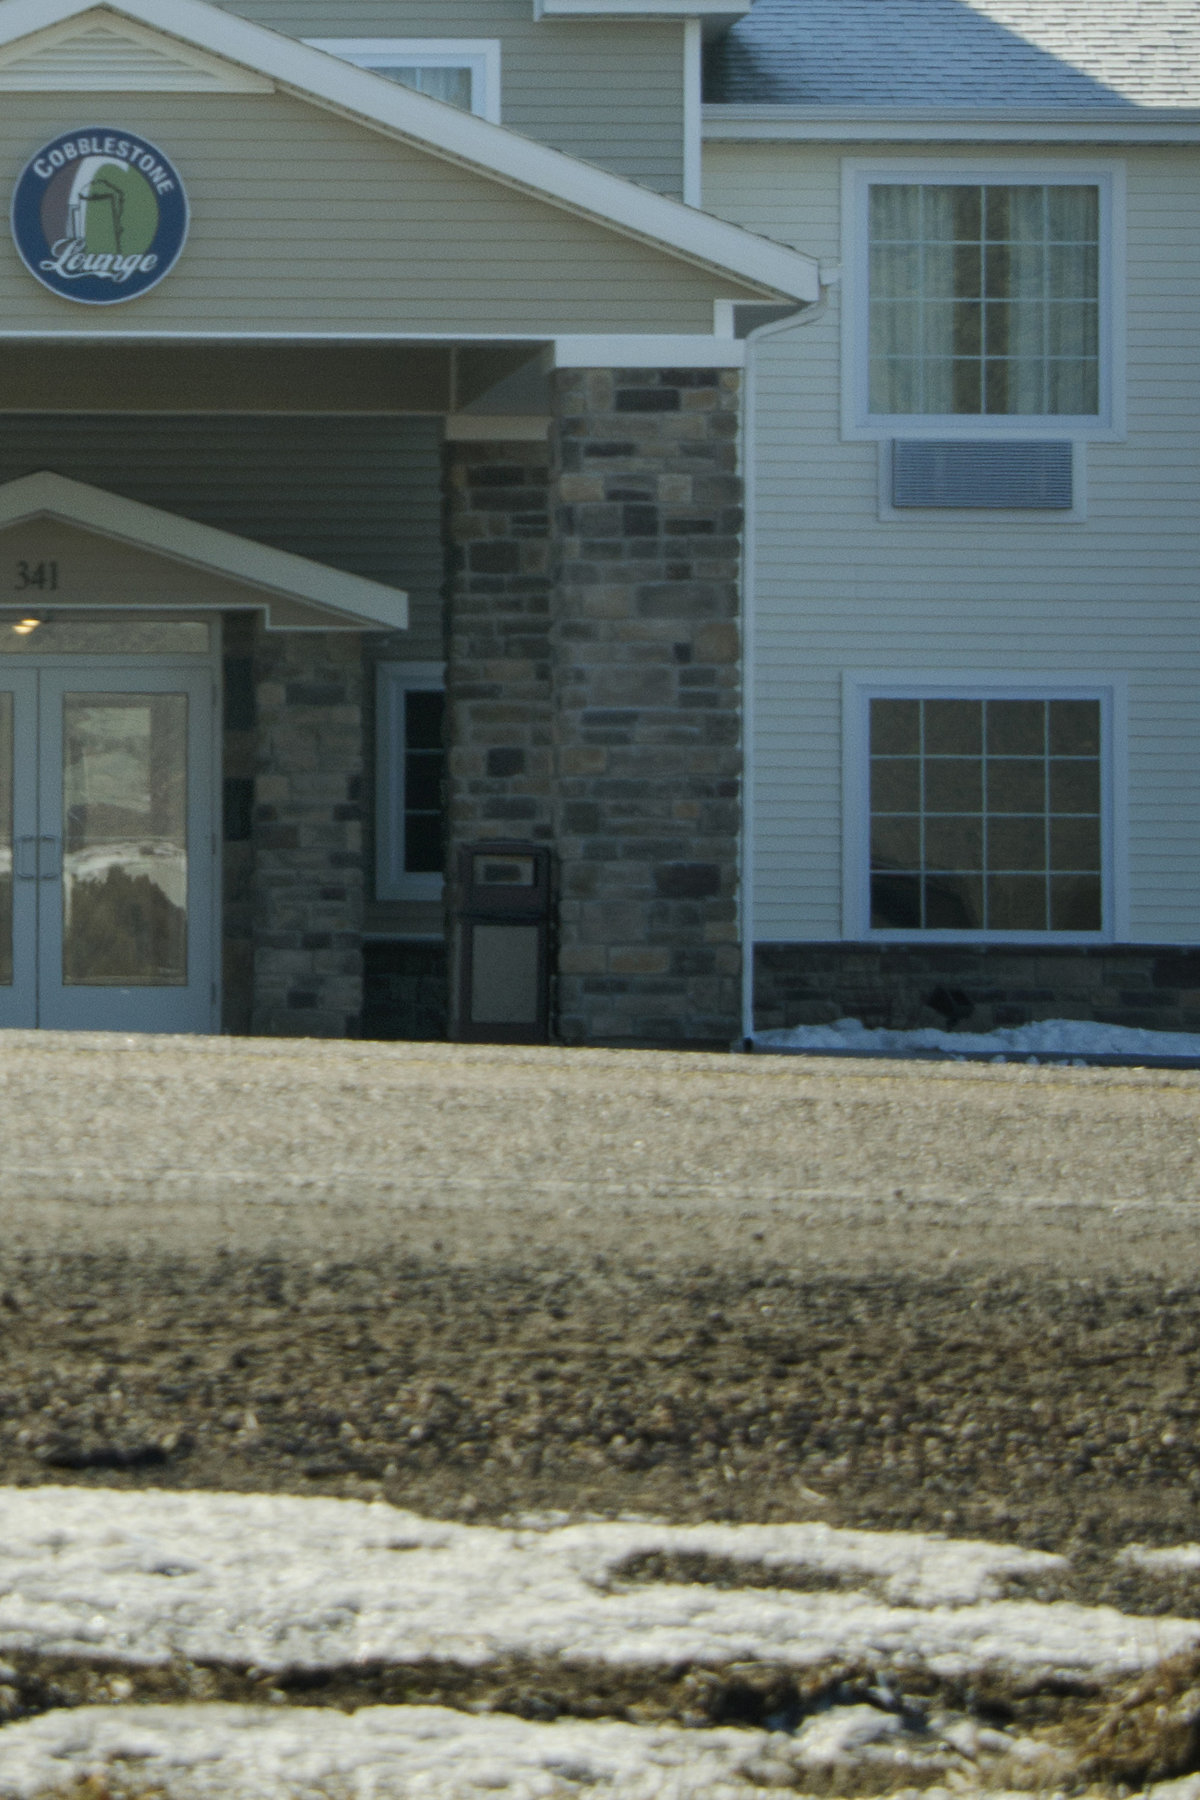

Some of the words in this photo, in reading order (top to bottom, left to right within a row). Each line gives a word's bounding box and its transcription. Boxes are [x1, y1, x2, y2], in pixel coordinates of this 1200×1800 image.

[33, 137, 175, 195] COBBLESTONE
[39, 238, 159, 283] Lounge
[15, 560, 58, 591] 341
